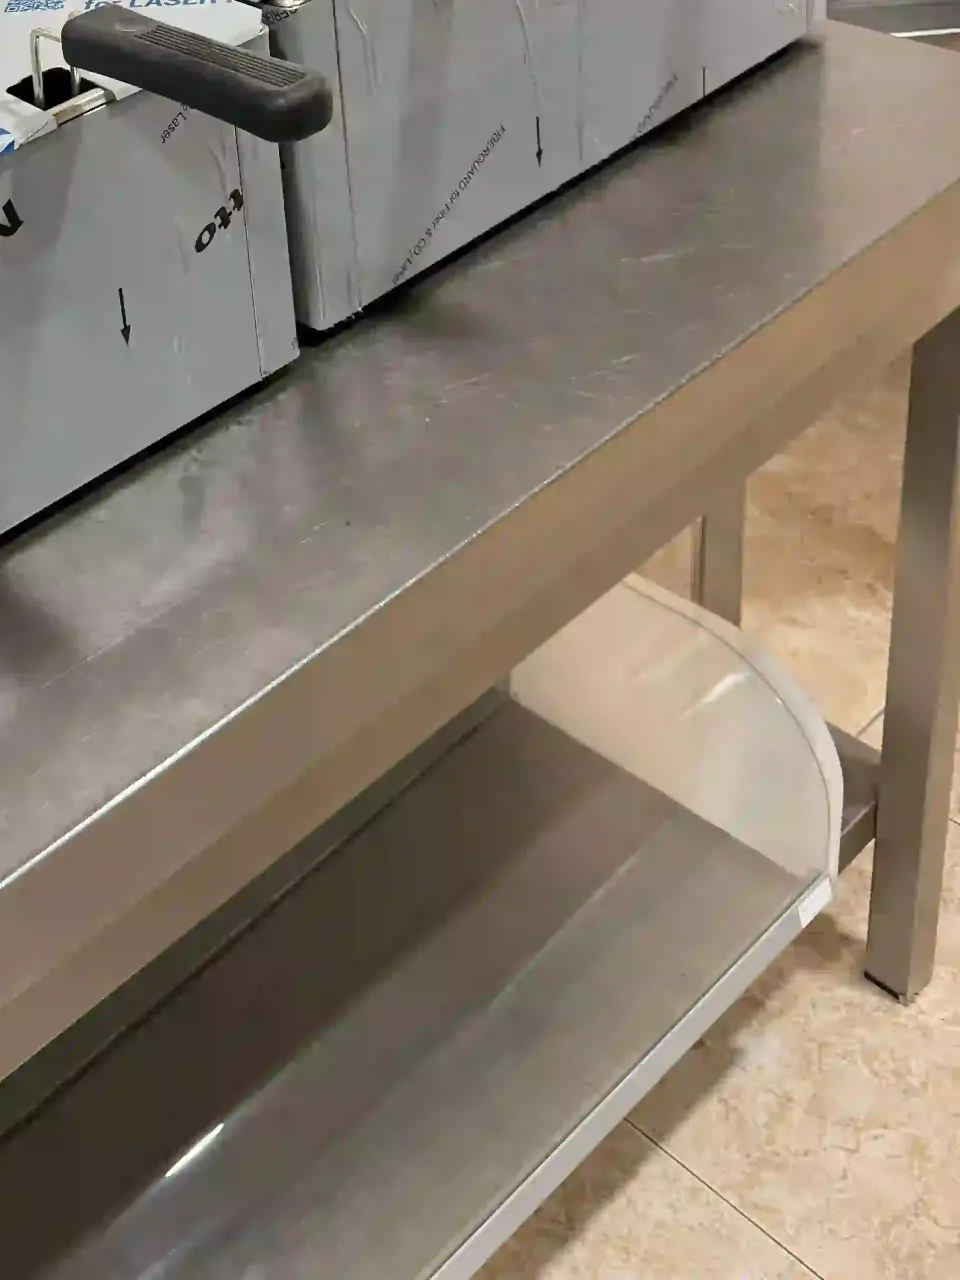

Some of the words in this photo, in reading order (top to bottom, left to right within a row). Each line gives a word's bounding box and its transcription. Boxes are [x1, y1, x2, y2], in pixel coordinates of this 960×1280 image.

[160, 111, 188, 144] Laser
[458, 123, 507, 191] FIBERGUARD
[194, 188, 245, 253] tto
